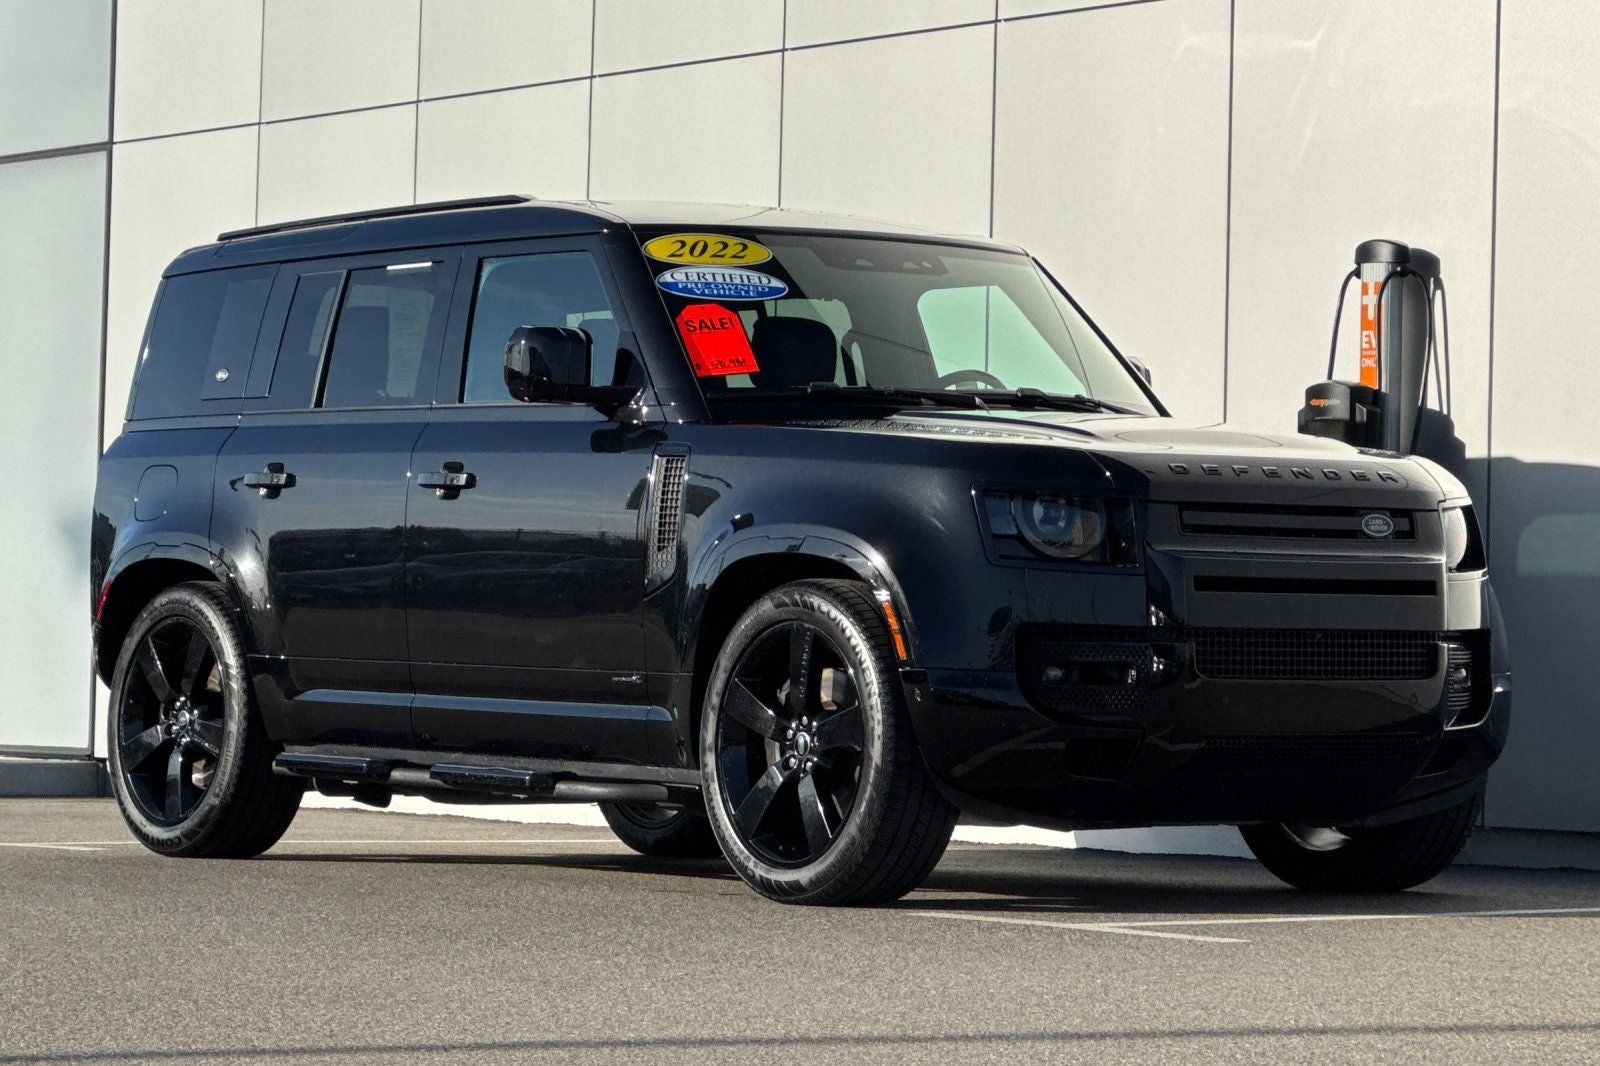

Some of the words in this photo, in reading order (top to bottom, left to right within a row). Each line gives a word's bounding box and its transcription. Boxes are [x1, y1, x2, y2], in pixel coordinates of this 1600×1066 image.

[666, 239, 749, 259] 2022
[670, 270, 772, 286] CERTIFIED
[677, 282, 770, 293] PRE-OWNED
[693, 287, 759, 297] VEHICLE
[684, 316, 734, 333] SALE!
[1168, 463, 1400, 484] DEFENDER
